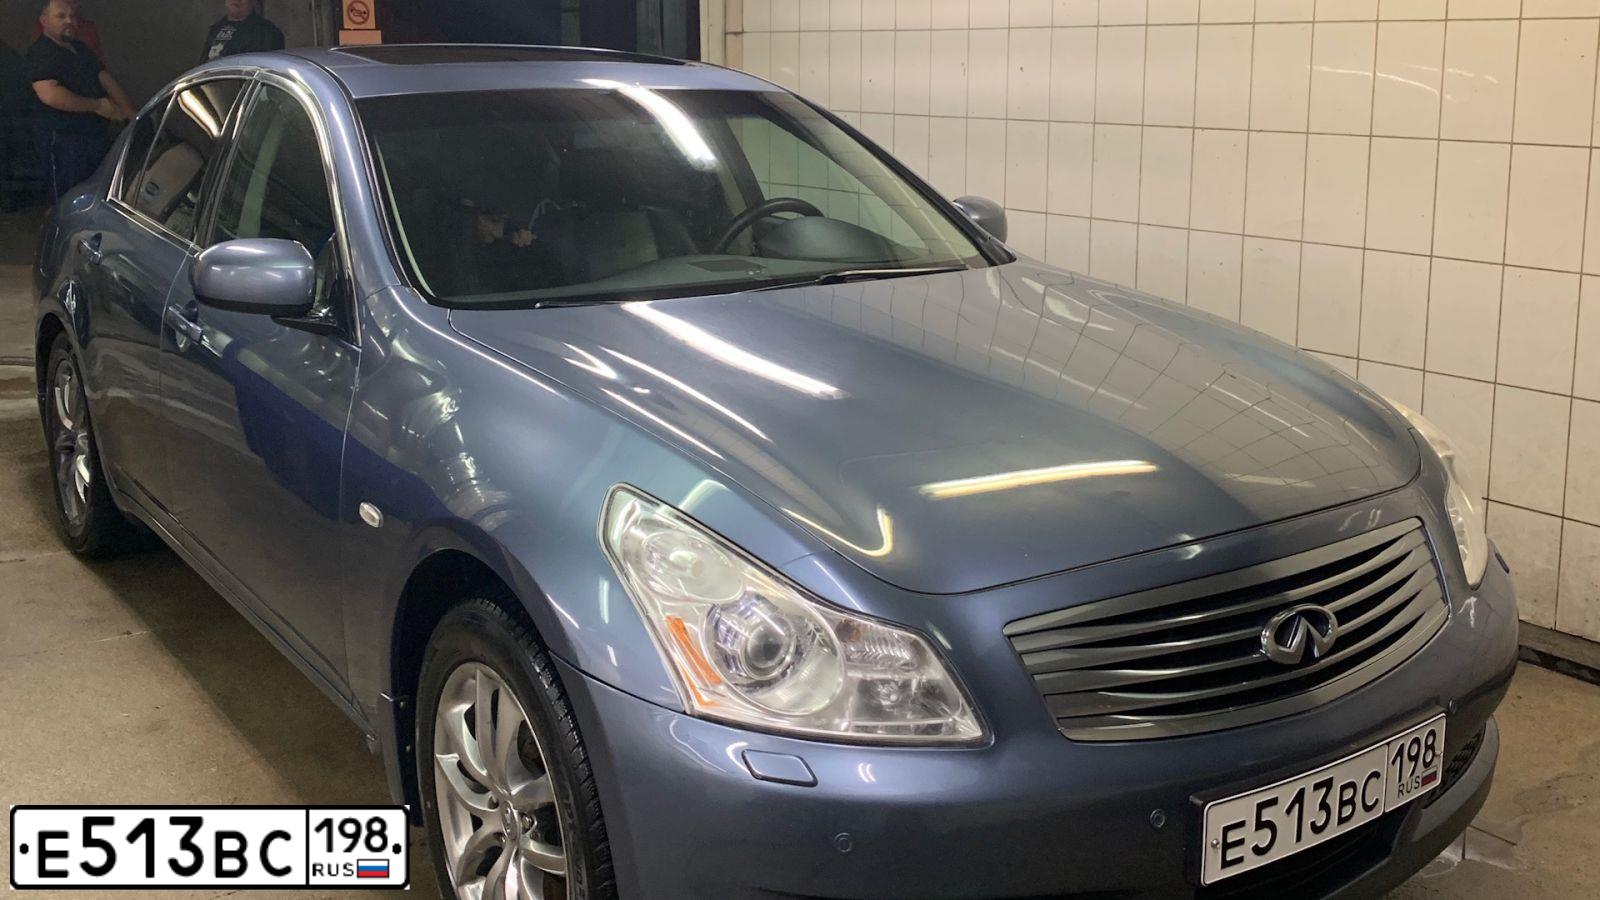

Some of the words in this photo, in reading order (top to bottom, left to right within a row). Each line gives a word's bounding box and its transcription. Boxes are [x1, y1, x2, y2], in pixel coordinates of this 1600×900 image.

[1220, 770, 1381, 870] E513BC
[1391, 728, 1436, 784] 198
[1397, 775, 1421, 799] RUS
